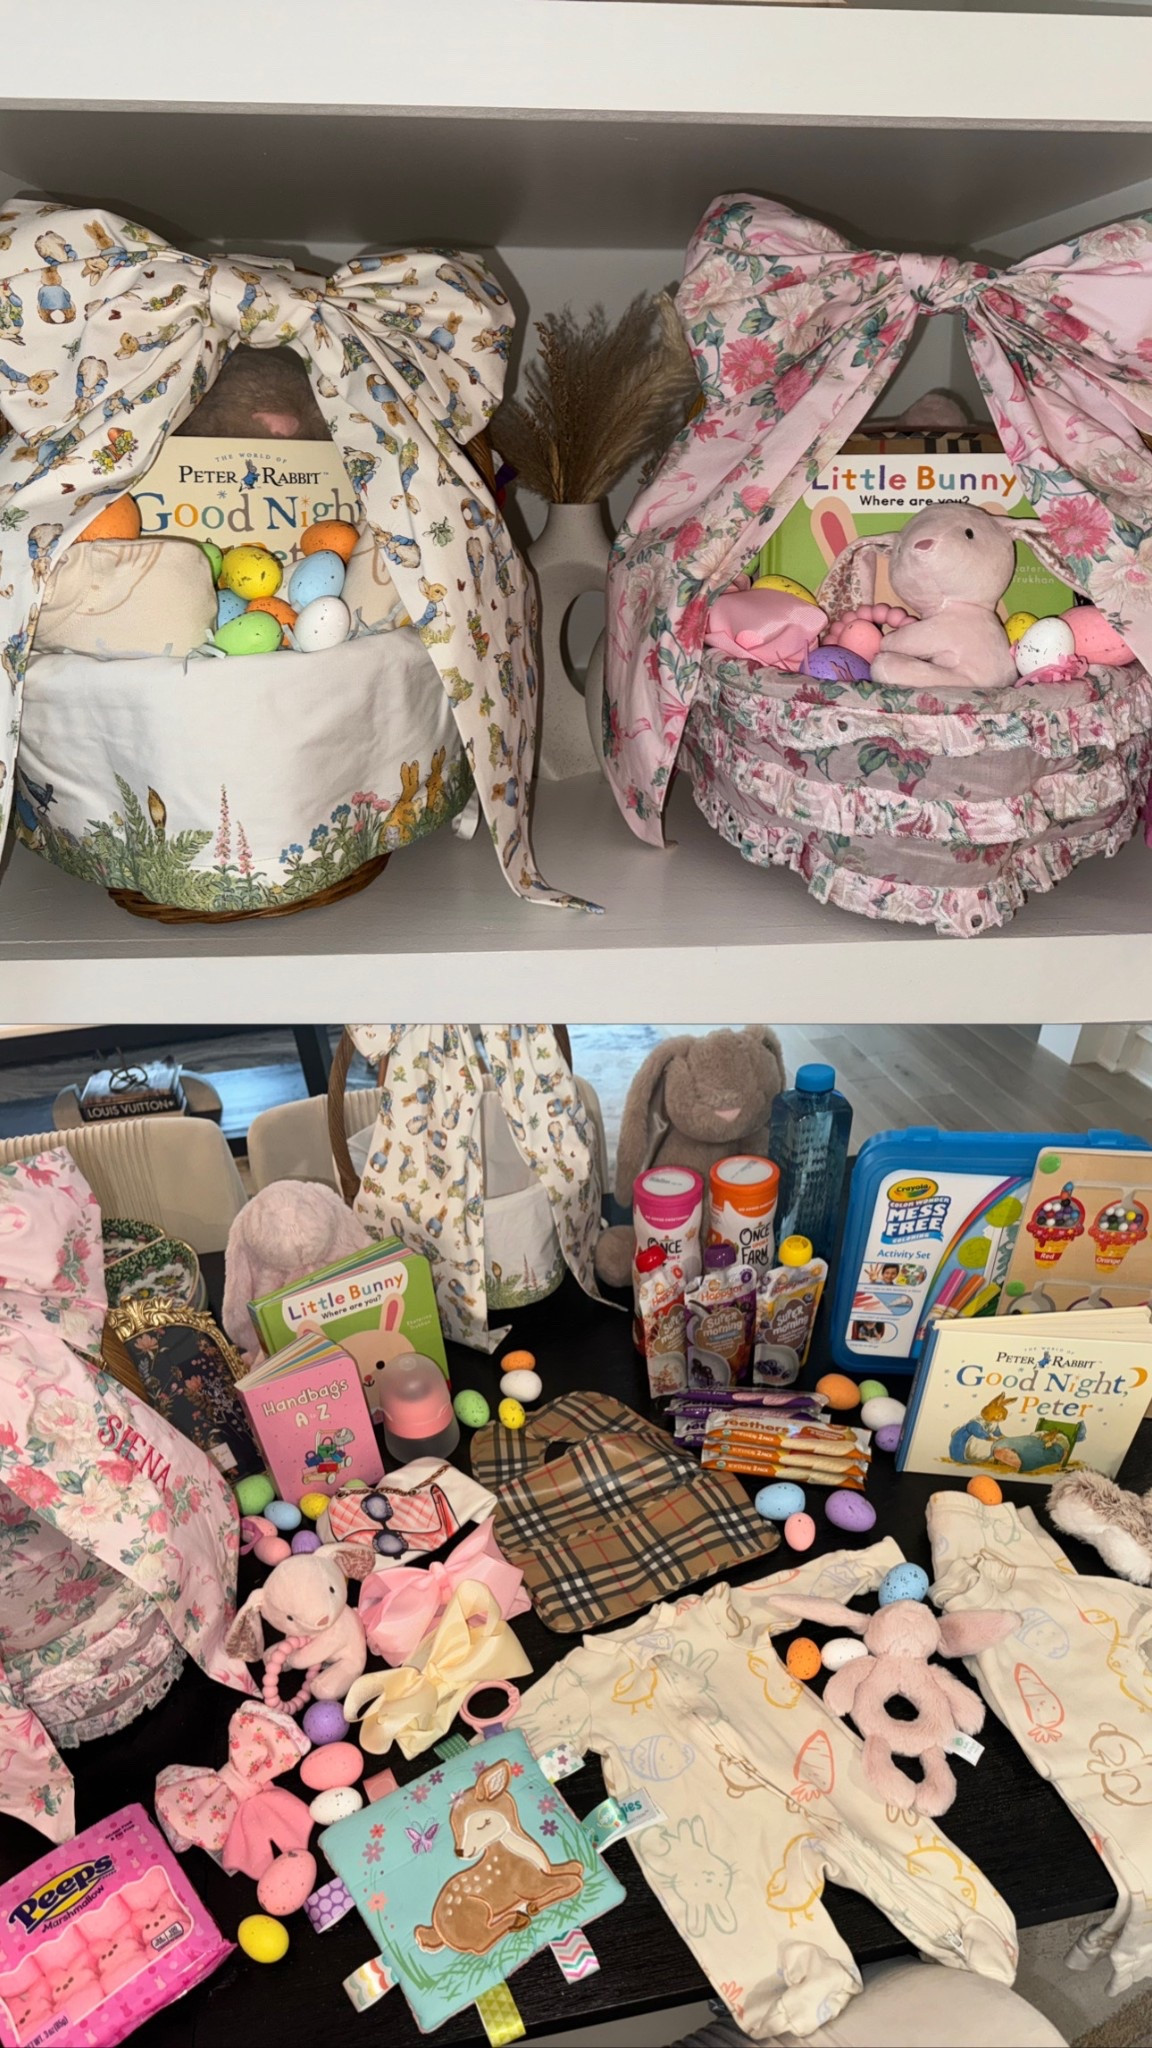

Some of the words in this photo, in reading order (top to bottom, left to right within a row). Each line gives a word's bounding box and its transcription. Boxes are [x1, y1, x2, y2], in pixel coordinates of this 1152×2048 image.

[215, 454, 233, 462] THE
[178, 465, 237, 483] PETER
[262, 467, 321, 485] RABBIT
[917, 465, 1017, 497] Bunny
[860, 495, 905, 506] Where
[909, 498, 933, 506] are
[134, 492, 255, 532] Good
[87, 1105, 120, 1119] LOUIS
[120, 1100, 168, 1114] VUITTON
[896, 1184, 930, 1192] Crayola
[887, 1203, 947, 1222] MESS
[739, 1222, 771, 1246] ONCE
[885, 1217, 943, 1236] FREE
[741, 1244, 769, 1266] FARM
[877, 1249, 913, 1260] Activity
[915, 1250, 931, 1259] Set
[1040, 1252, 1055, 1260] Red
[1096, 1257, 1120, 1265] Orange
[288, 1292, 346, 1321] Little
[348, 1273, 404, 1300] Bunny
[321, 1306, 348, 1320] Where
[350, 1301, 363, 1310] are
[364, 1295, 382, 1309] you?
[703, 1321, 743, 1337] morning
[772, 1315, 809, 1336] morning
[996, 1351, 1035, 1365] PETER
[1052, 1355, 1097, 1369] RABBIT
[956, 1365, 1039, 1392] Good
[1043, 1371, 1129, 1399] Night,
[262, 1379, 349, 1417] Handbags
[1019, 1396, 1094, 1418] Peter
[295, 1411, 309, 1428] A
[316, 1403, 331, 1421] Z
[98, 1414, 172, 1492] SIENA
[8, 1854, 114, 1934] Peeps
[42, 1885, 105, 1933] Marshmallow
